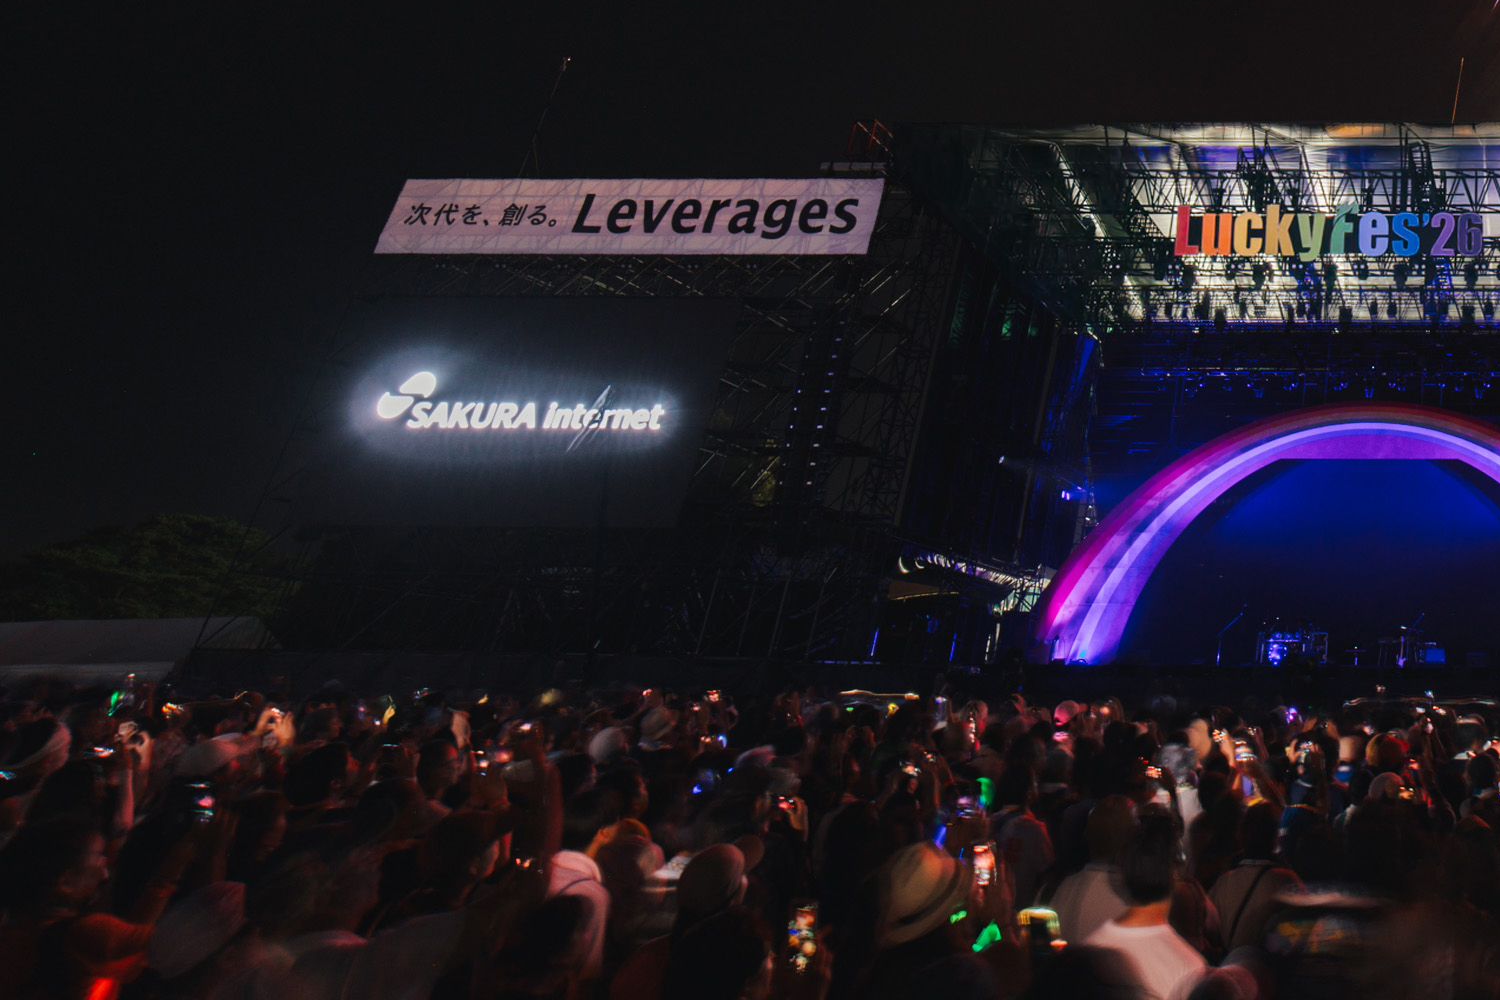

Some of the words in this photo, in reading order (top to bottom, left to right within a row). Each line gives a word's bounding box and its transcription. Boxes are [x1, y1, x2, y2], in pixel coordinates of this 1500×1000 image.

[403, 202, 560, 227] 次代を、創る。
[571, 193, 860, 239] Leverages
[406, 402, 536, 430] SAKURA
[542, 402, 665, 430] internet
